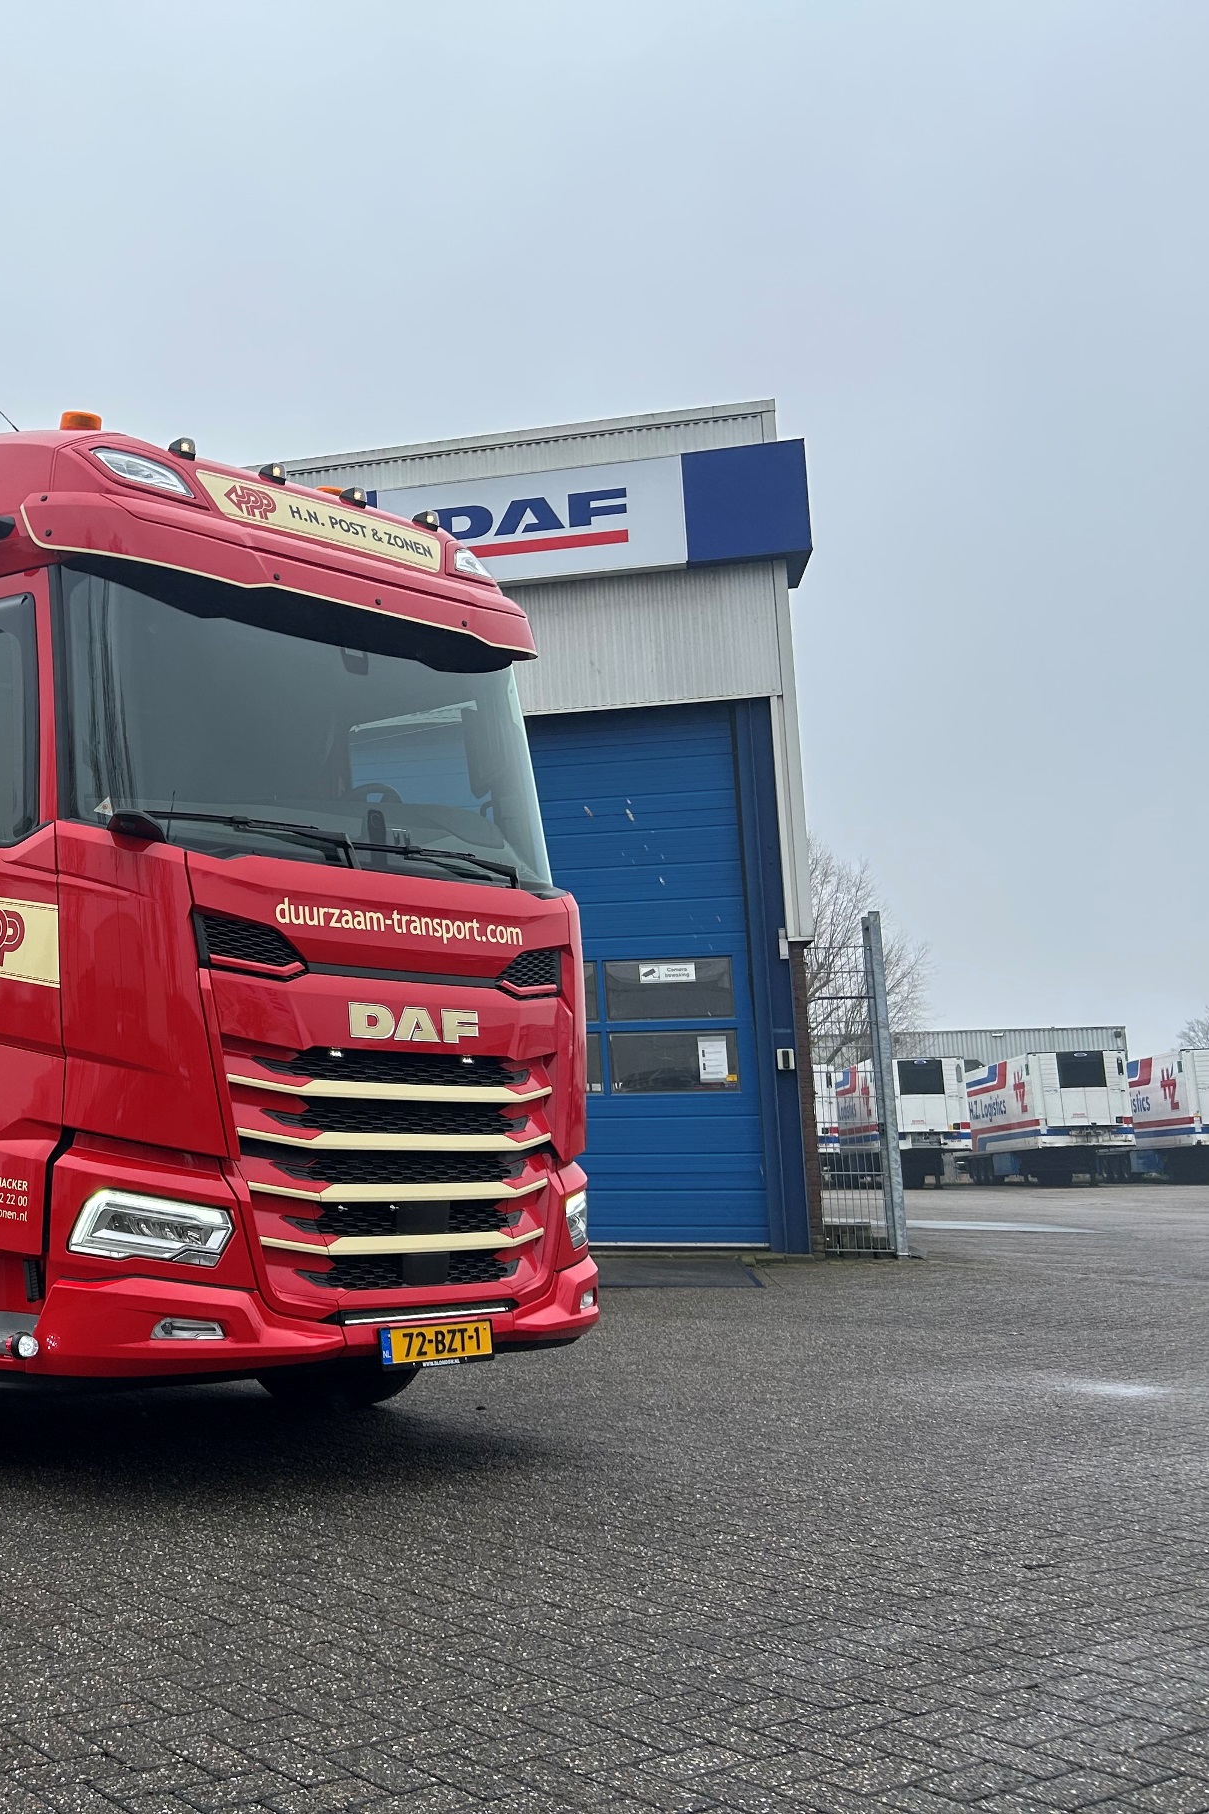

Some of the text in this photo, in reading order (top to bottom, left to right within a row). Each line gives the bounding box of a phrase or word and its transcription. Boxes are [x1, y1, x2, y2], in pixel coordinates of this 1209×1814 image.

[288, 504, 325, 527] H.N.
[328, 515, 367, 538] POST
[371, 528, 385, 543] &
[384, 531, 434, 559] ZONEN
[432, 487, 627, 541] DAF
[275, 897, 523, 946] duurzaam-transport.com
[347, 1001, 479, 1044] DAF
[980, 1094, 1007, 1122] Logistics
[5, 1193, 16, 1205] 22
[17, 1195, 28, 1207] 00
[382, 1326, 481, 1359] NL 72-BZT-1
